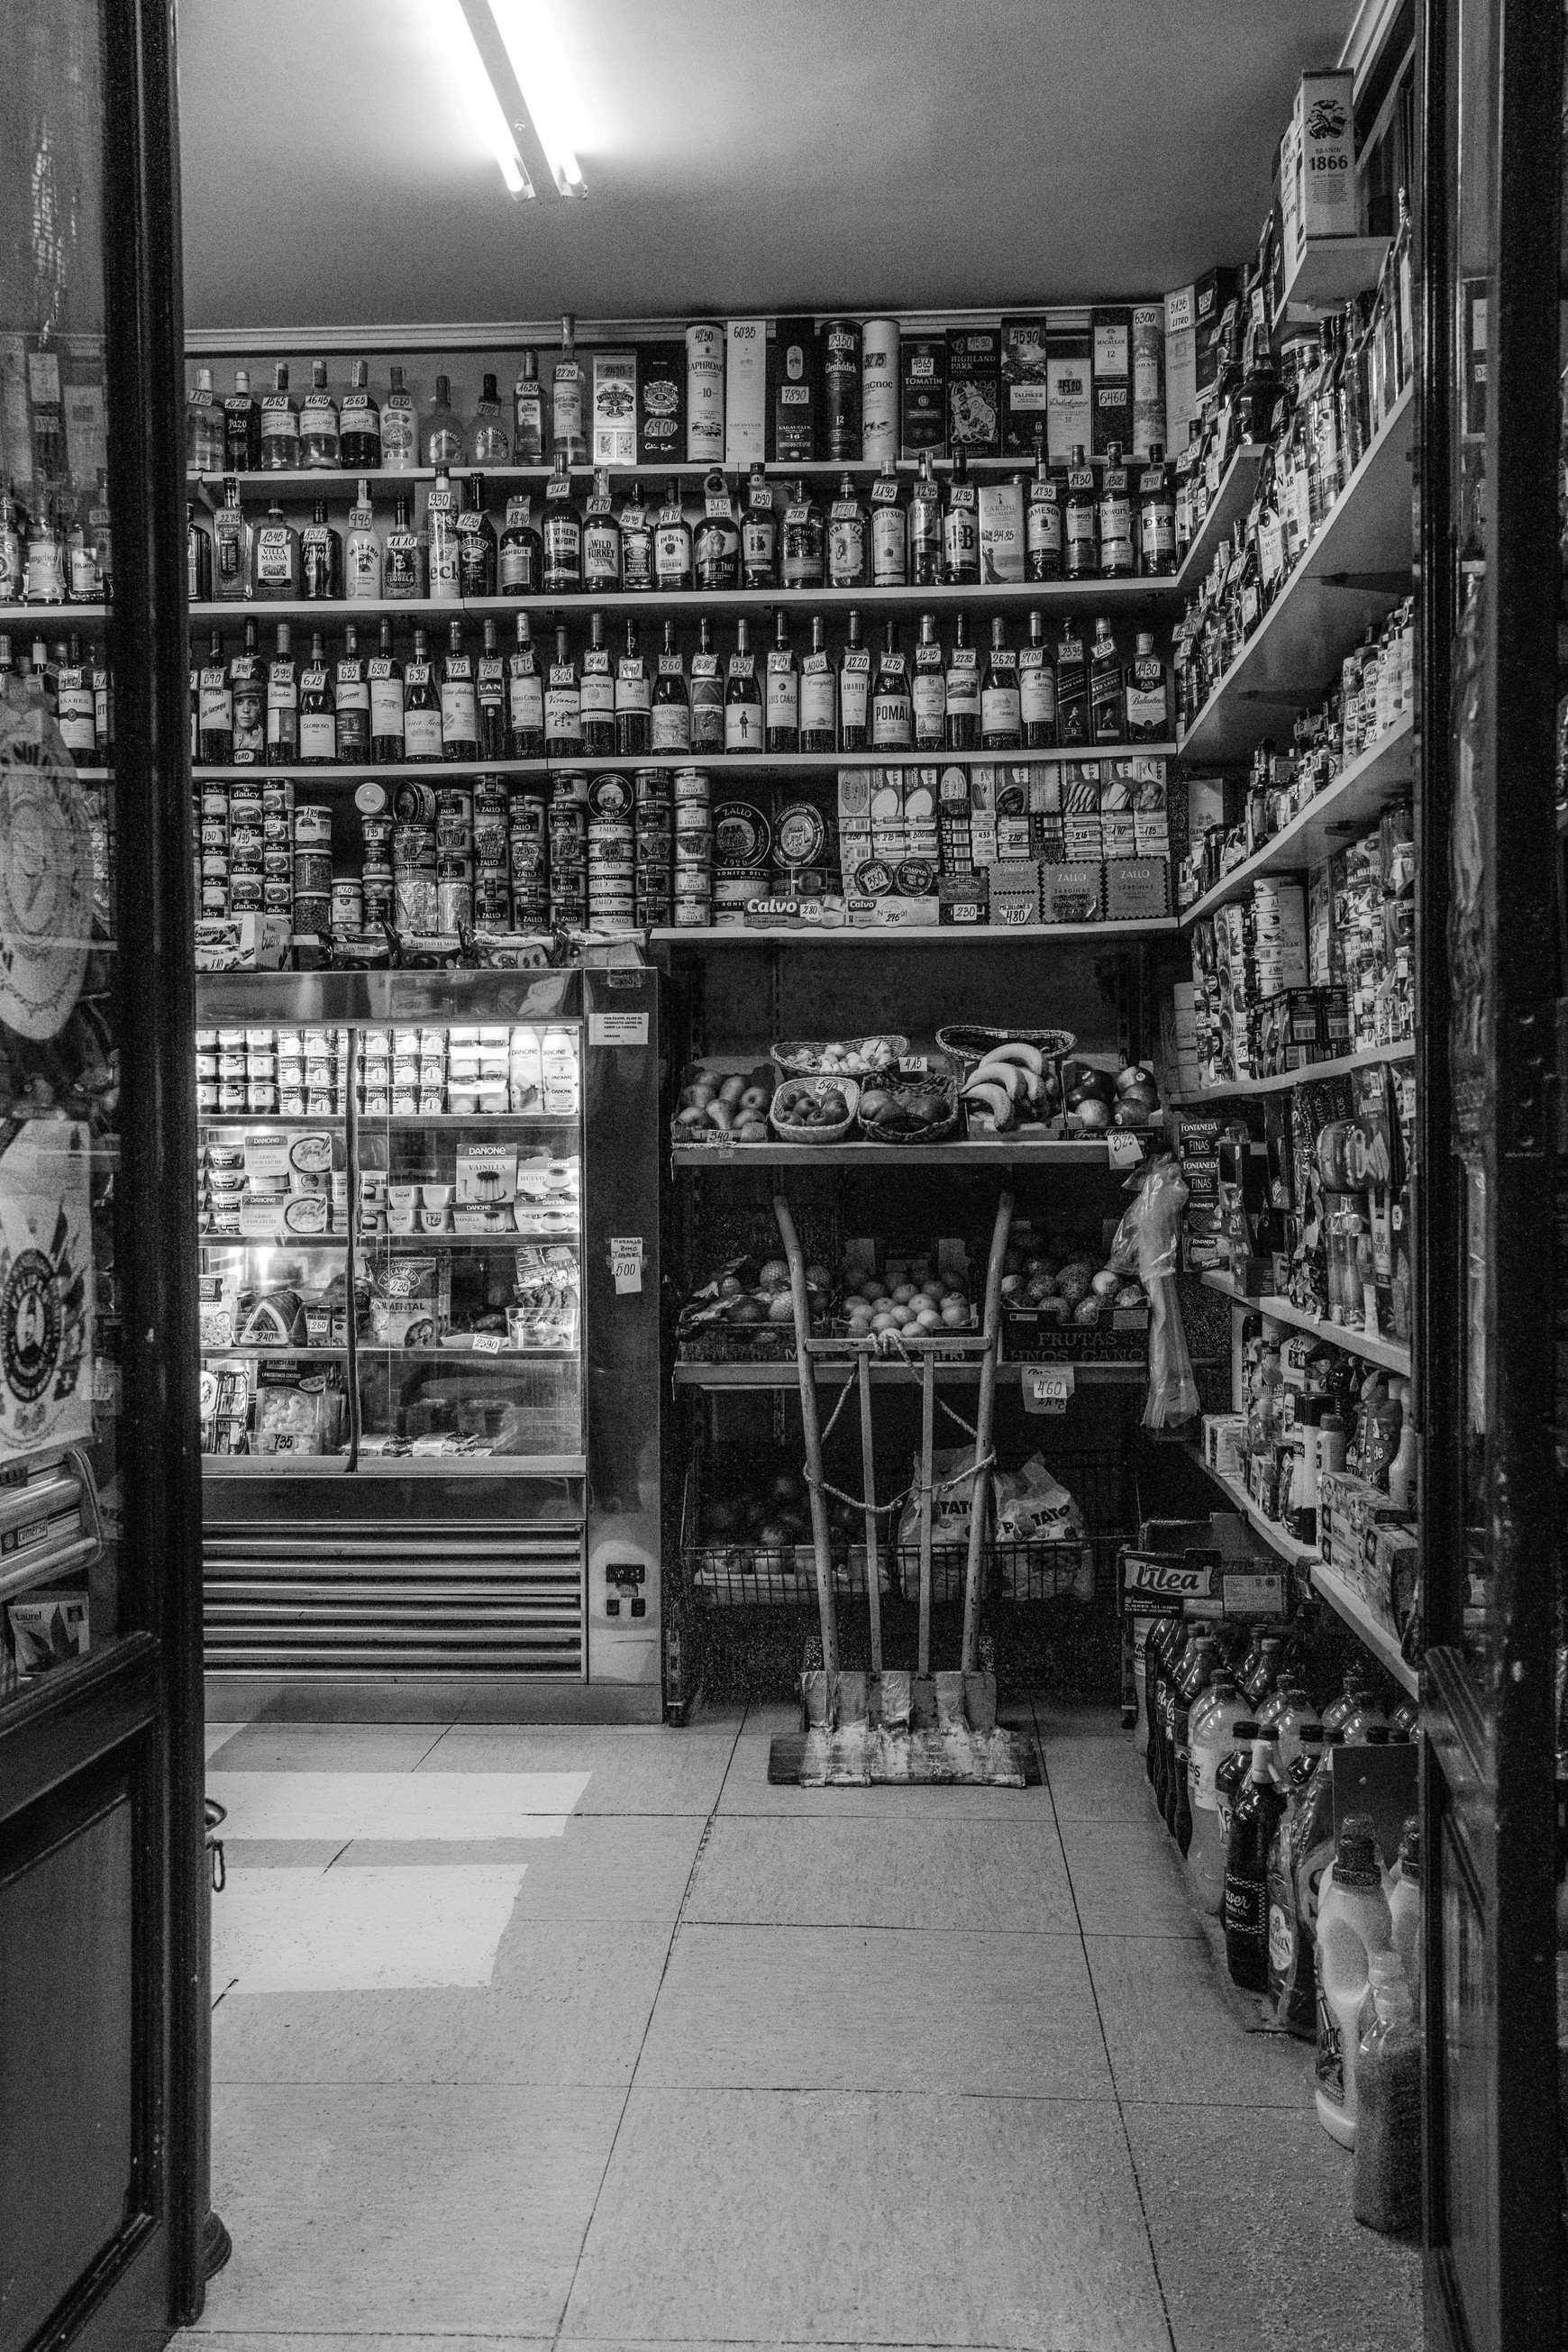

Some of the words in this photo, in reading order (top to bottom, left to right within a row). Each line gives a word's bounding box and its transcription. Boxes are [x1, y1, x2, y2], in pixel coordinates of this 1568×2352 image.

[1308, 155, 1348, 170] 1866
[951, 355, 996, 363] HIGHLAND
[825, 361, 856, 373] Glenfiddich
[905, 378, 943, 386] TOMATIN
[835, 415, 844, 425] 12
[1027, 506, 1060, 518] JAMESON
[591, 540, 611, 549] WILD
[349, 543, 379, 558] MALIBU
[588, 549, 615, 559] TURKEY
[769, 695, 779, 704] LUIS
[876, 706, 909, 721] POMAL
[723, 807, 752, 817] ZALLO
[723, 858, 748, 867] 1926
[902, 867, 927, 876] CAMPOS
[1121, 871, 1150, 880] ZALLO
[1057, 873, 1086, 882] ZALLO
[747, 899, 798, 913] Calvo
[196, 930, 219, 938] bueno
[1181, 1124, 1217, 1133] FONTANEDA
[469, 1146, 506, 1155] DANONE
[1190, 1140, 1209, 1151] FINAS
[1038, 1333, 1117, 1345] FRUTAS
[15, 1610, 42, 1621] Laurel
